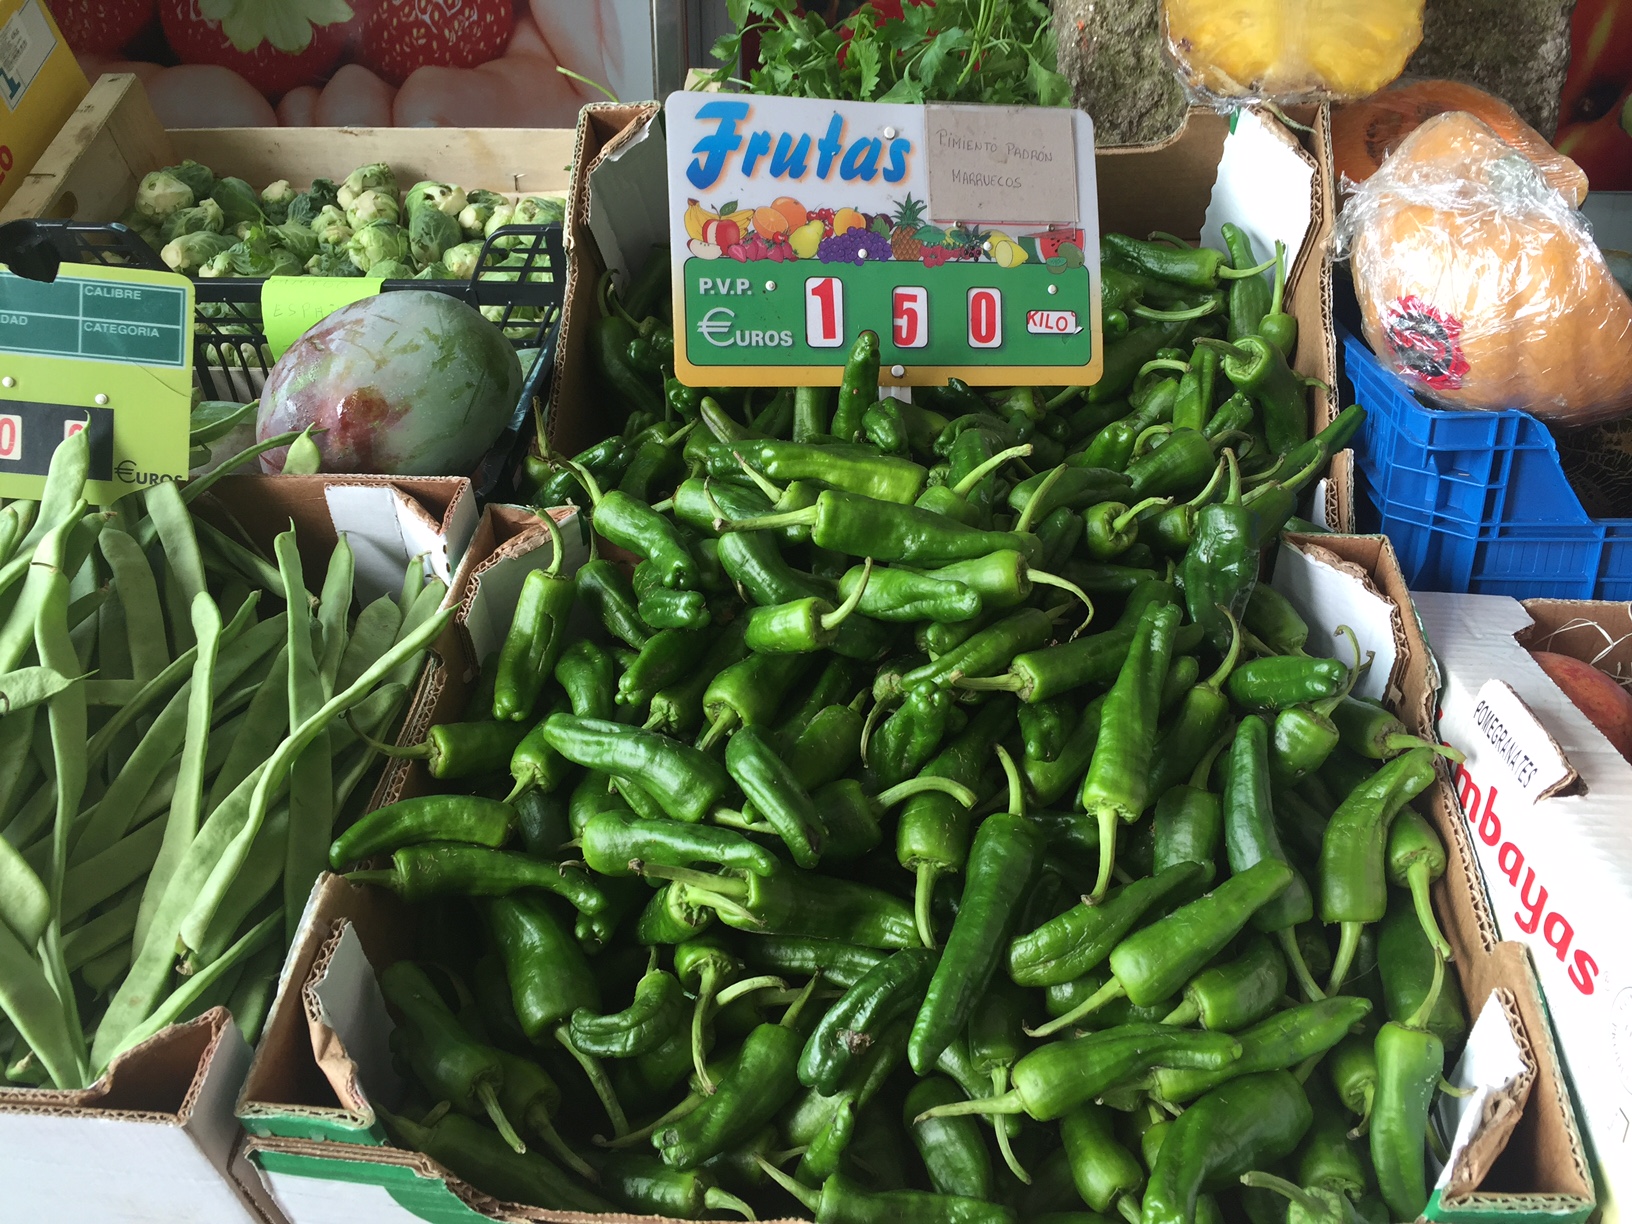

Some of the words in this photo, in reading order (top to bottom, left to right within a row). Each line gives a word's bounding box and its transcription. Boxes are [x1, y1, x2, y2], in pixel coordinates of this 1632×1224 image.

[686, 101, 912, 190] Frutas
[936, 128, 998, 152] PIMIENTO
[1005, 142, 1053, 162] PADRÓN
[951, 168, 1022, 188] MARRUECOS
[84, 286, 142, 300] CALIBRE
[699, 277, 752, 295] P.V.P.
[83, 322, 160, 338] CATEGORIA
[1027, 310, 1069, 332] KILO
[1473, 700, 1538, 788] POMEGRANATES
